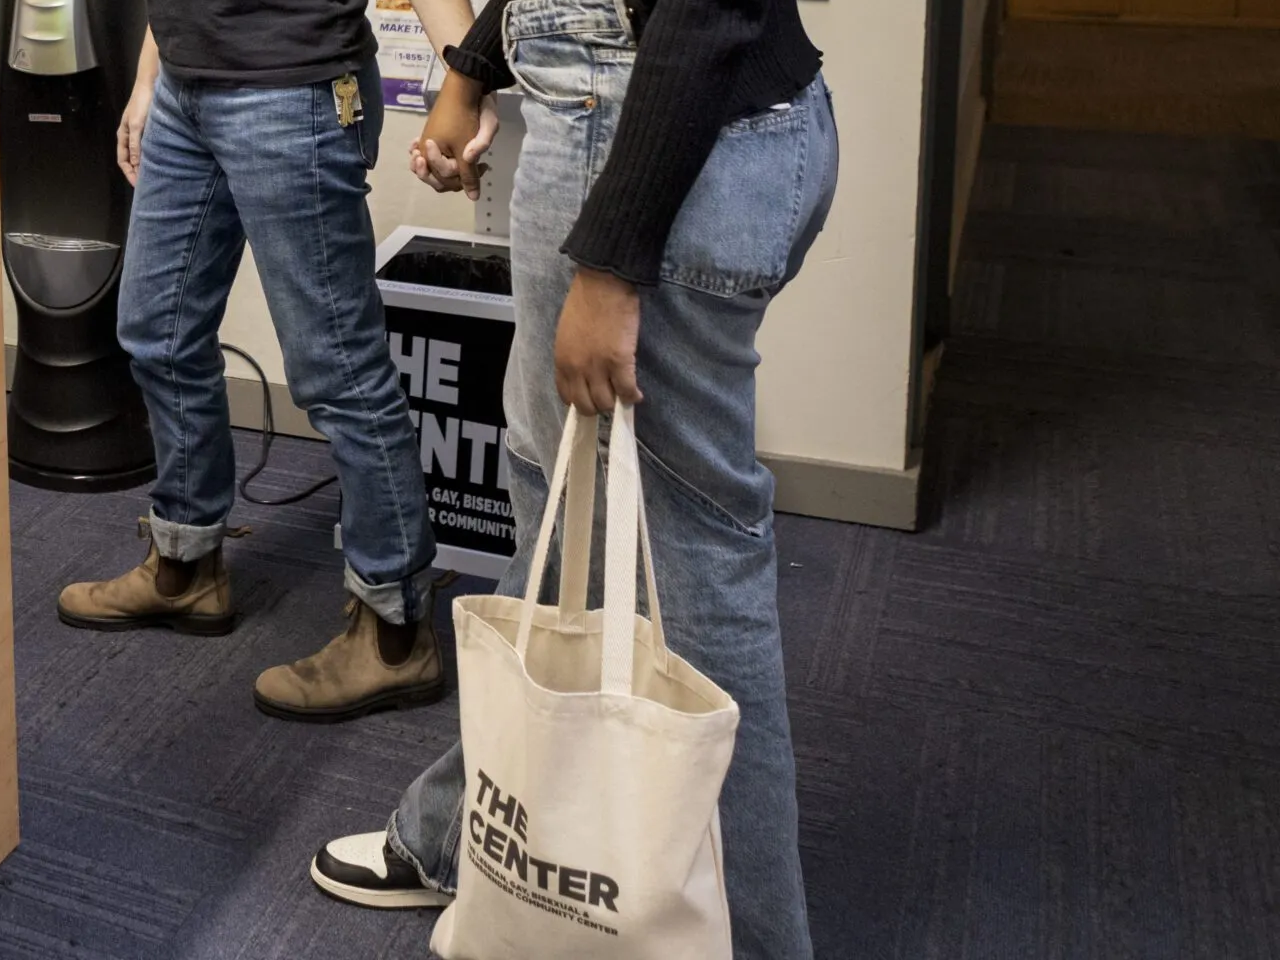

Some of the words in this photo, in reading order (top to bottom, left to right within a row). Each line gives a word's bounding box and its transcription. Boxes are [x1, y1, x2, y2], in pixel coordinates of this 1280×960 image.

[379, 23, 411, 34] MAKE
[385, 331, 461, 405] HE
[432, 487, 460, 509] GAY,
[463, 494, 514, 518] BISEXU
[439, 510, 517, 540] COMMUNITY
[476, 768, 528, 844] THE
[470, 810, 619, 913] CENTER
[476, 851, 509, 885] LESBIAN,
[510, 880, 530, 897] GAY,
[532, 892, 581, 915] BISEXUAL
[515, 892, 574, 921] COMMUNITY
[577, 916, 619, 936] CENTER
